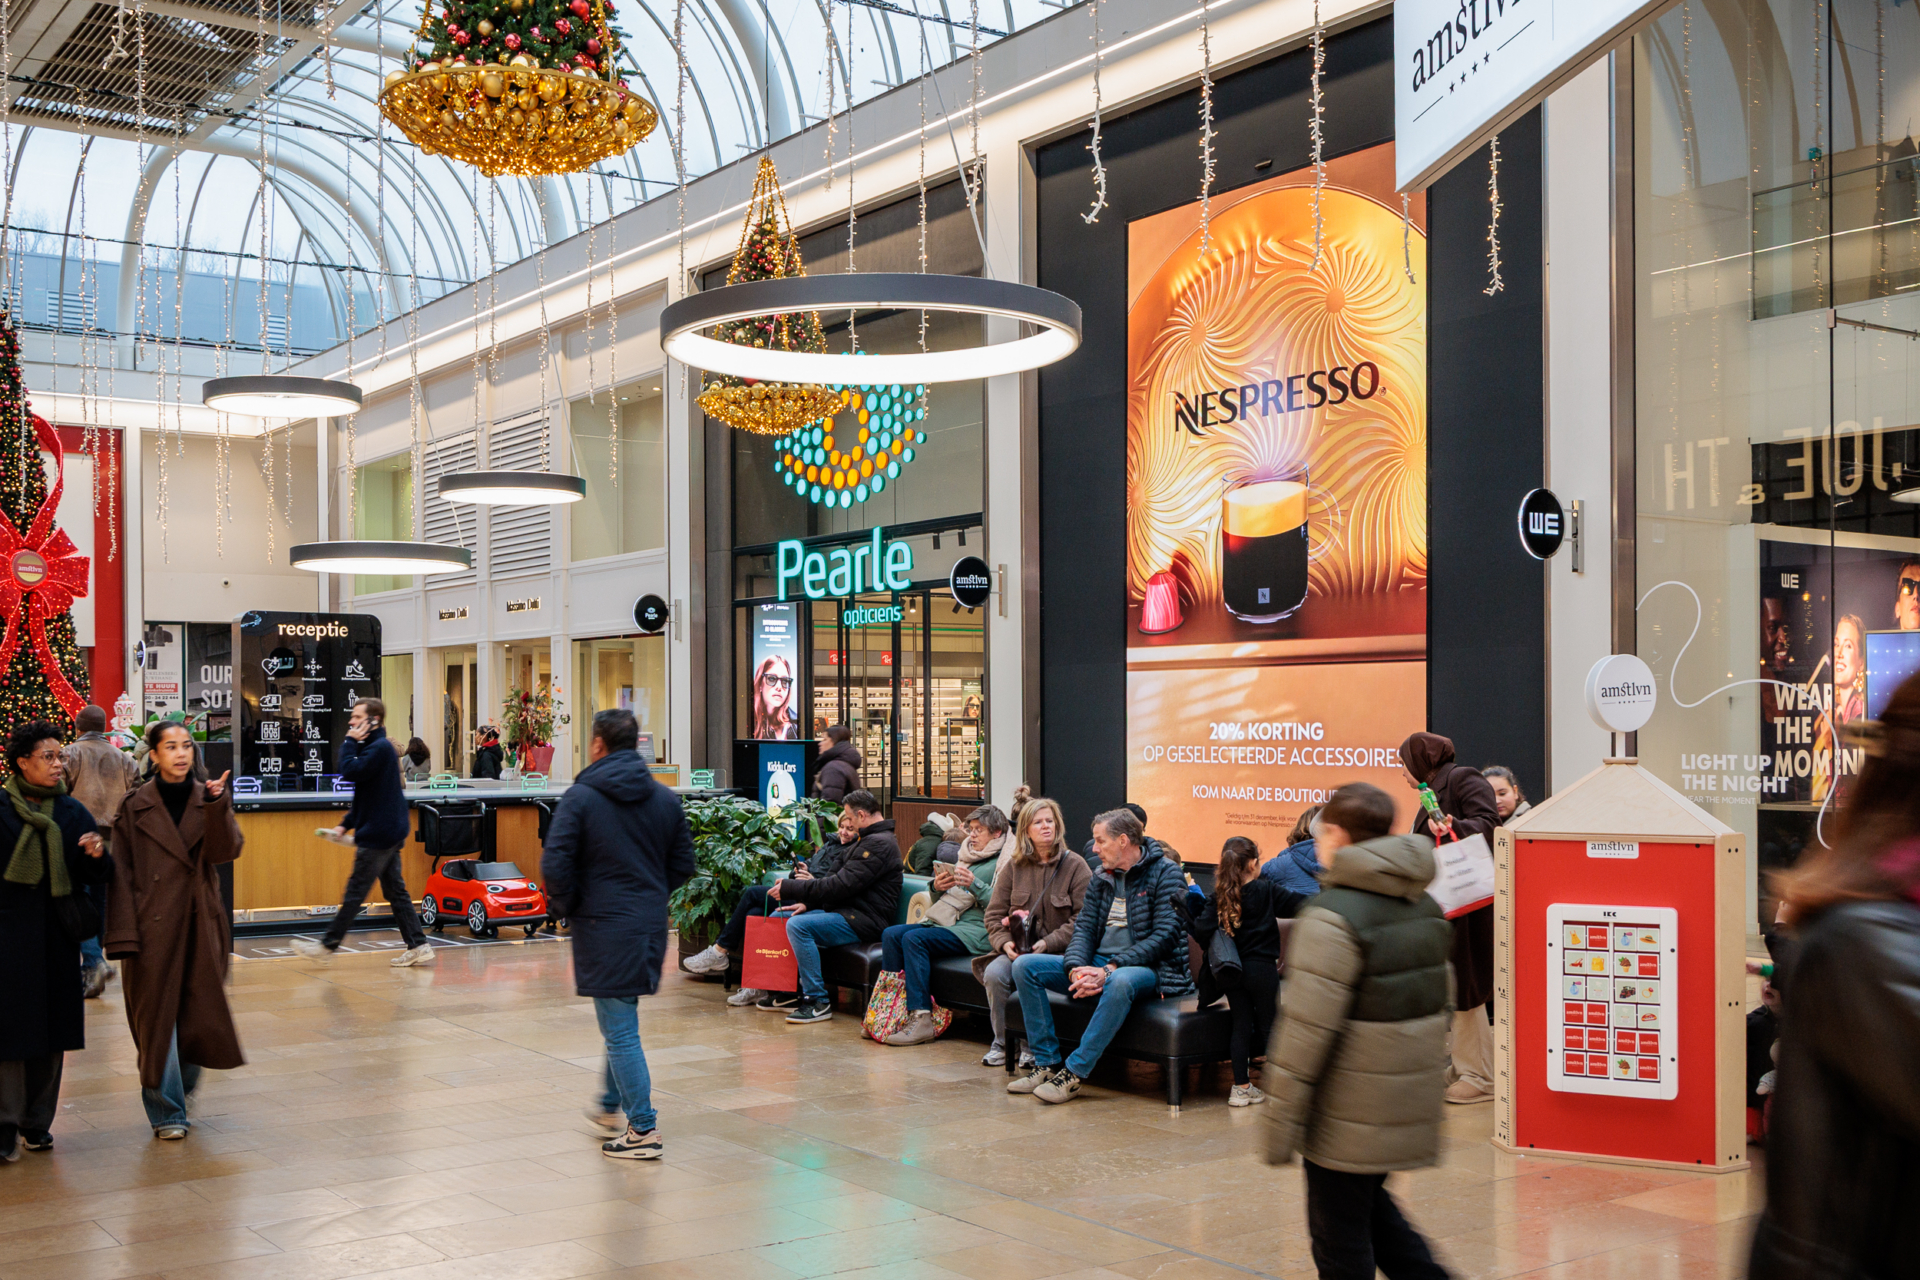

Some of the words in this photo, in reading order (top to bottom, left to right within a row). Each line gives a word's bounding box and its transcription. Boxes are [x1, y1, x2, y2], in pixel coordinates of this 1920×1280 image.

[1166, 360, 1380, 436] NESPRESSO
[1529, 511, 1559, 535] WE
[778, 526, 914, 600] Pearle
[956, 573, 988, 585] amstlvn
[1781, 572, 1799, 589] WE
[843, 605, 903, 629] opticiens
[277, 620, 349, 641] receptie
[200, 689, 222, 708] SO
[1601, 682, 1651, 698] amstlvn
[1209, 722, 1245, 740] 20%
[1247, 722, 1325, 741] KORTING
[1773, 716, 1812, 744] THE
[1143, 745, 1164, 763] OP
[1166, 745, 1287, 766] GESELECTEERDE
[1681, 753, 1738, 771] LIGHT
[1743, 754, 1772, 772] UP
[1774, 748, 1866, 778] MOMEN
[784, 761, 797, 773] Cars
[1682, 774, 1717, 791] THE
[1722, 775, 1790, 794] NIGHT
[1192, 785, 1219, 800] KOM
[1221, 786, 1255, 802] NAAR
[1257, 787, 1273, 803] DE
[1706, 795, 1722, 804] THE
[1724, 796, 1756, 805] MOMENT
[1591, 841, 1635, 851] amstlvn
